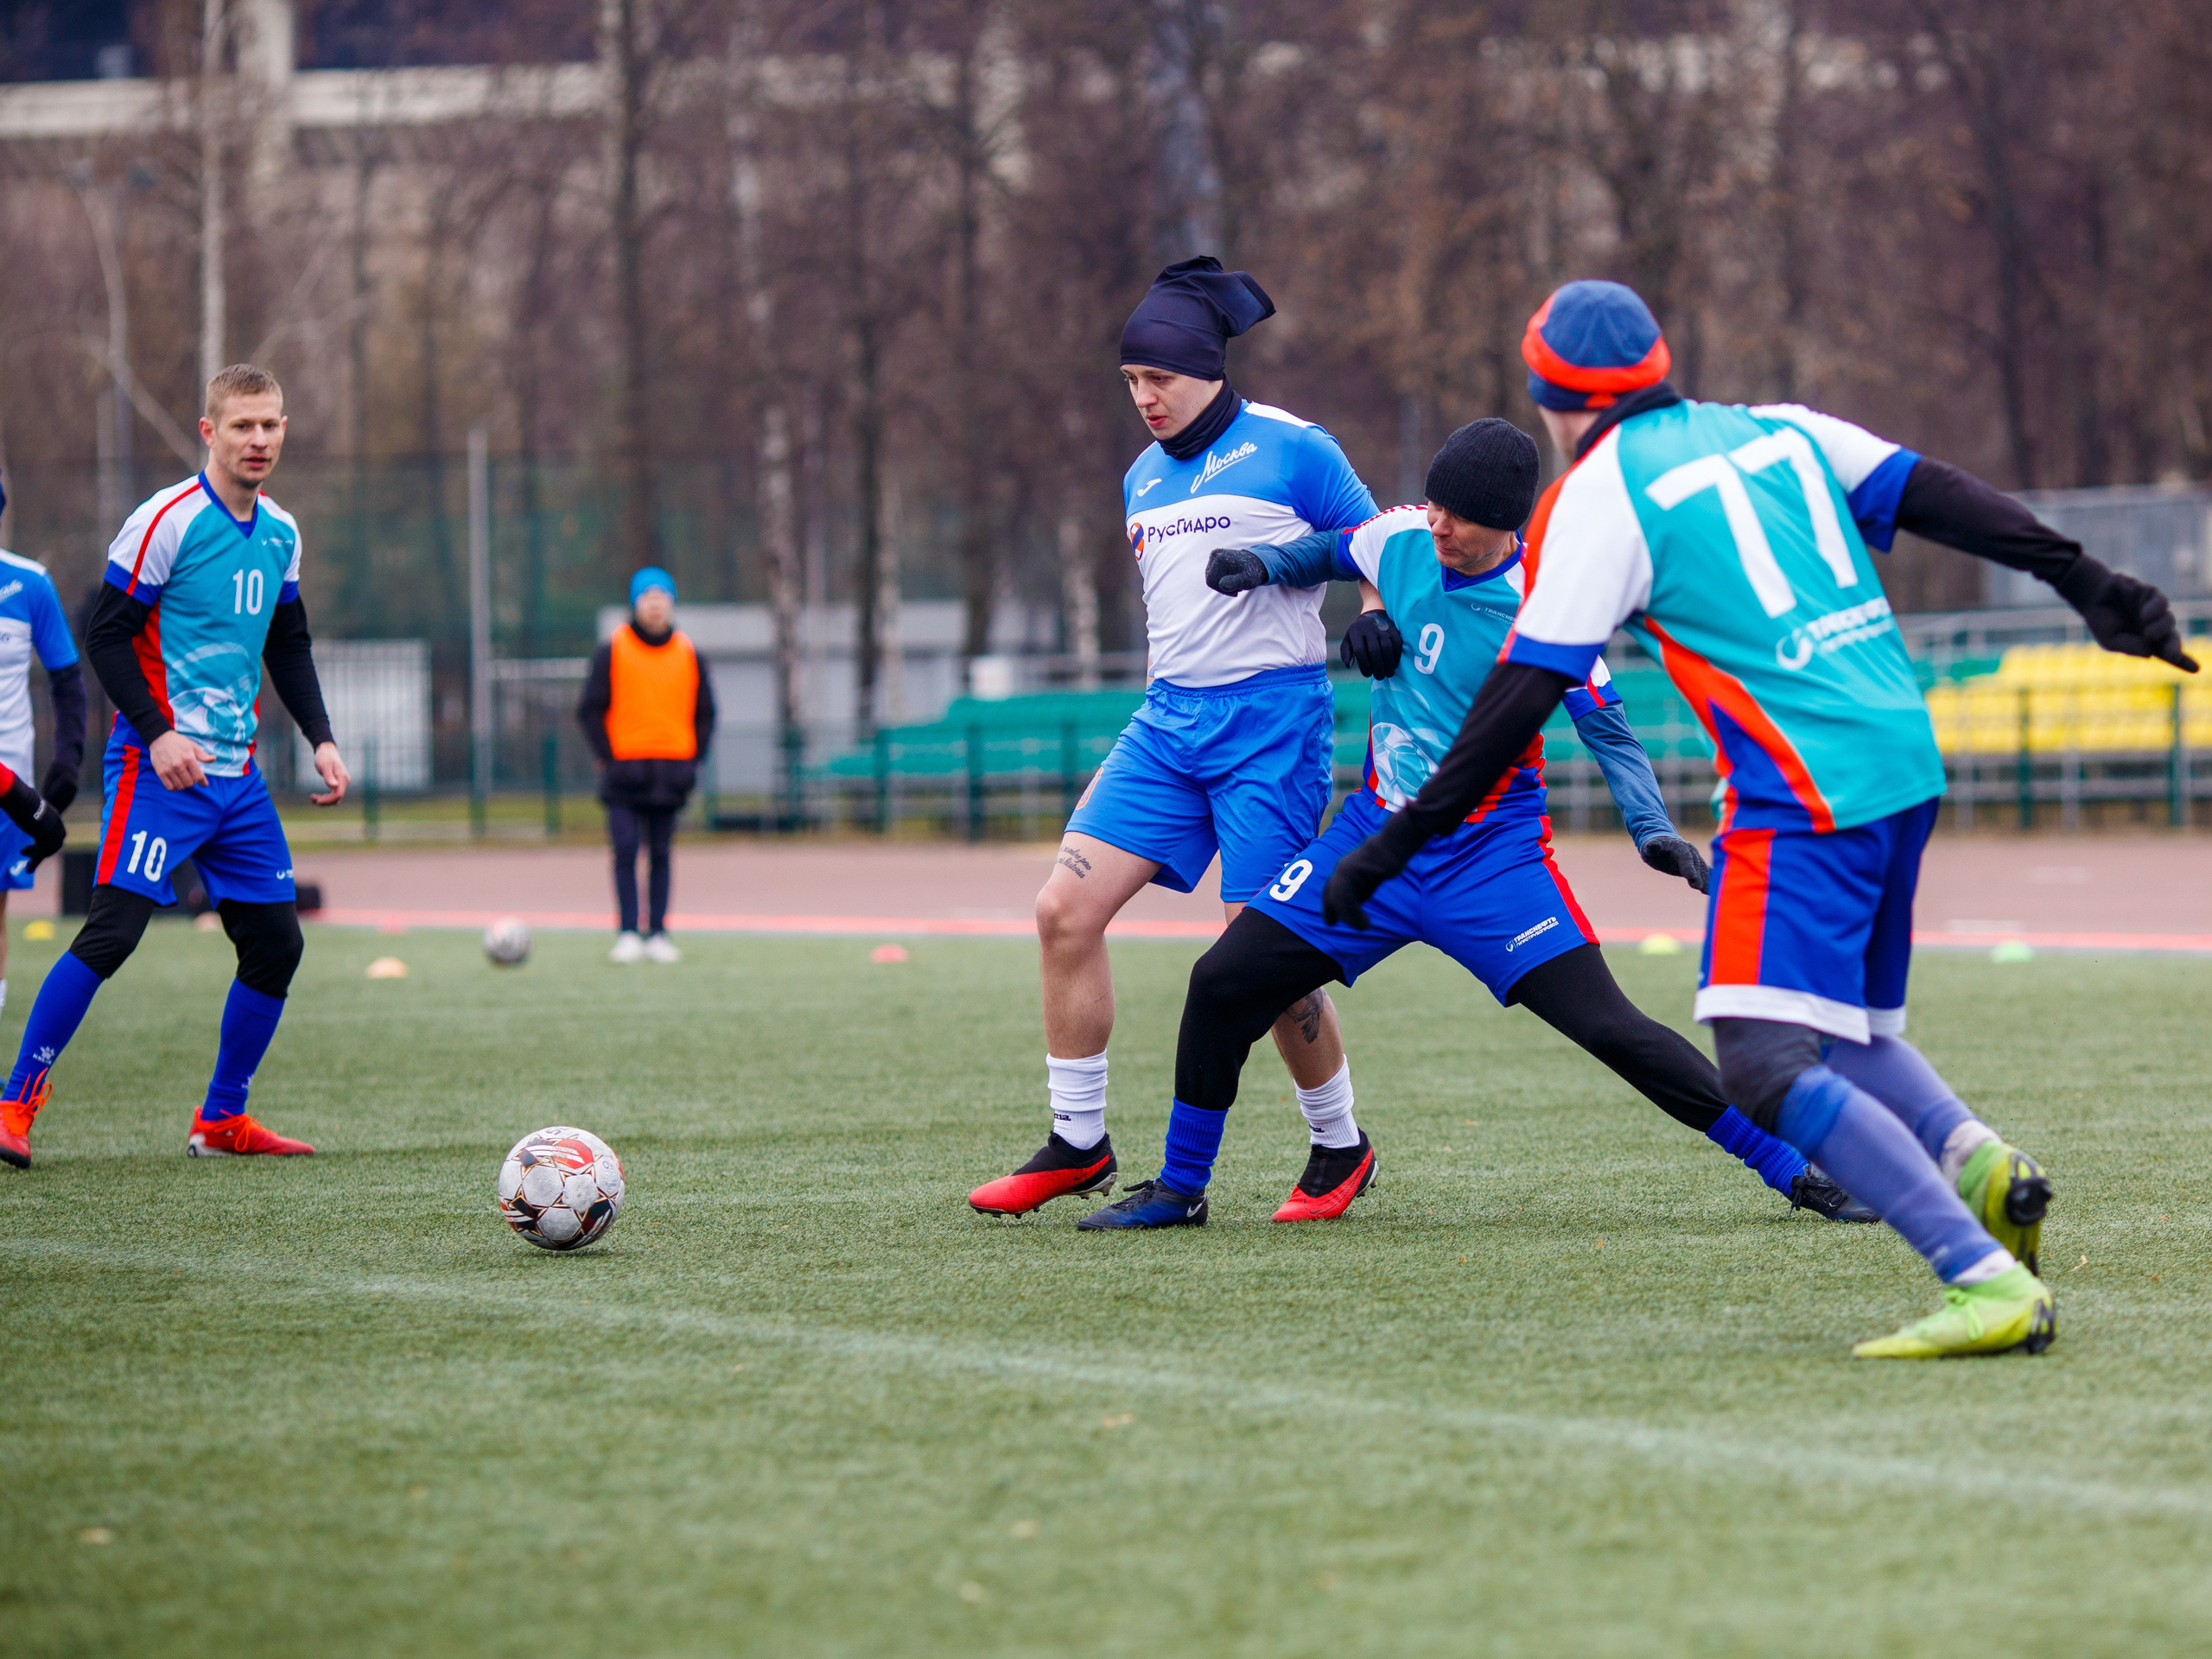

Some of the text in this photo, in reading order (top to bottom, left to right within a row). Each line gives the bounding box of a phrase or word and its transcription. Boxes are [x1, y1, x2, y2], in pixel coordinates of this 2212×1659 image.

[1190, 442, 1258, 493] Москва
[1147, 516, 1231, 543] РусГидро
[1643, 426, 1859, 620] 77
[232, 569, 264, 615] 10
[1414, 623, 1445, 675] 9
[127, 830, 167, 882] 10
[1268, 859, 1313, 901] 9
[1513, 916, 1557, 944] ТРАНСНЕФТЬ
